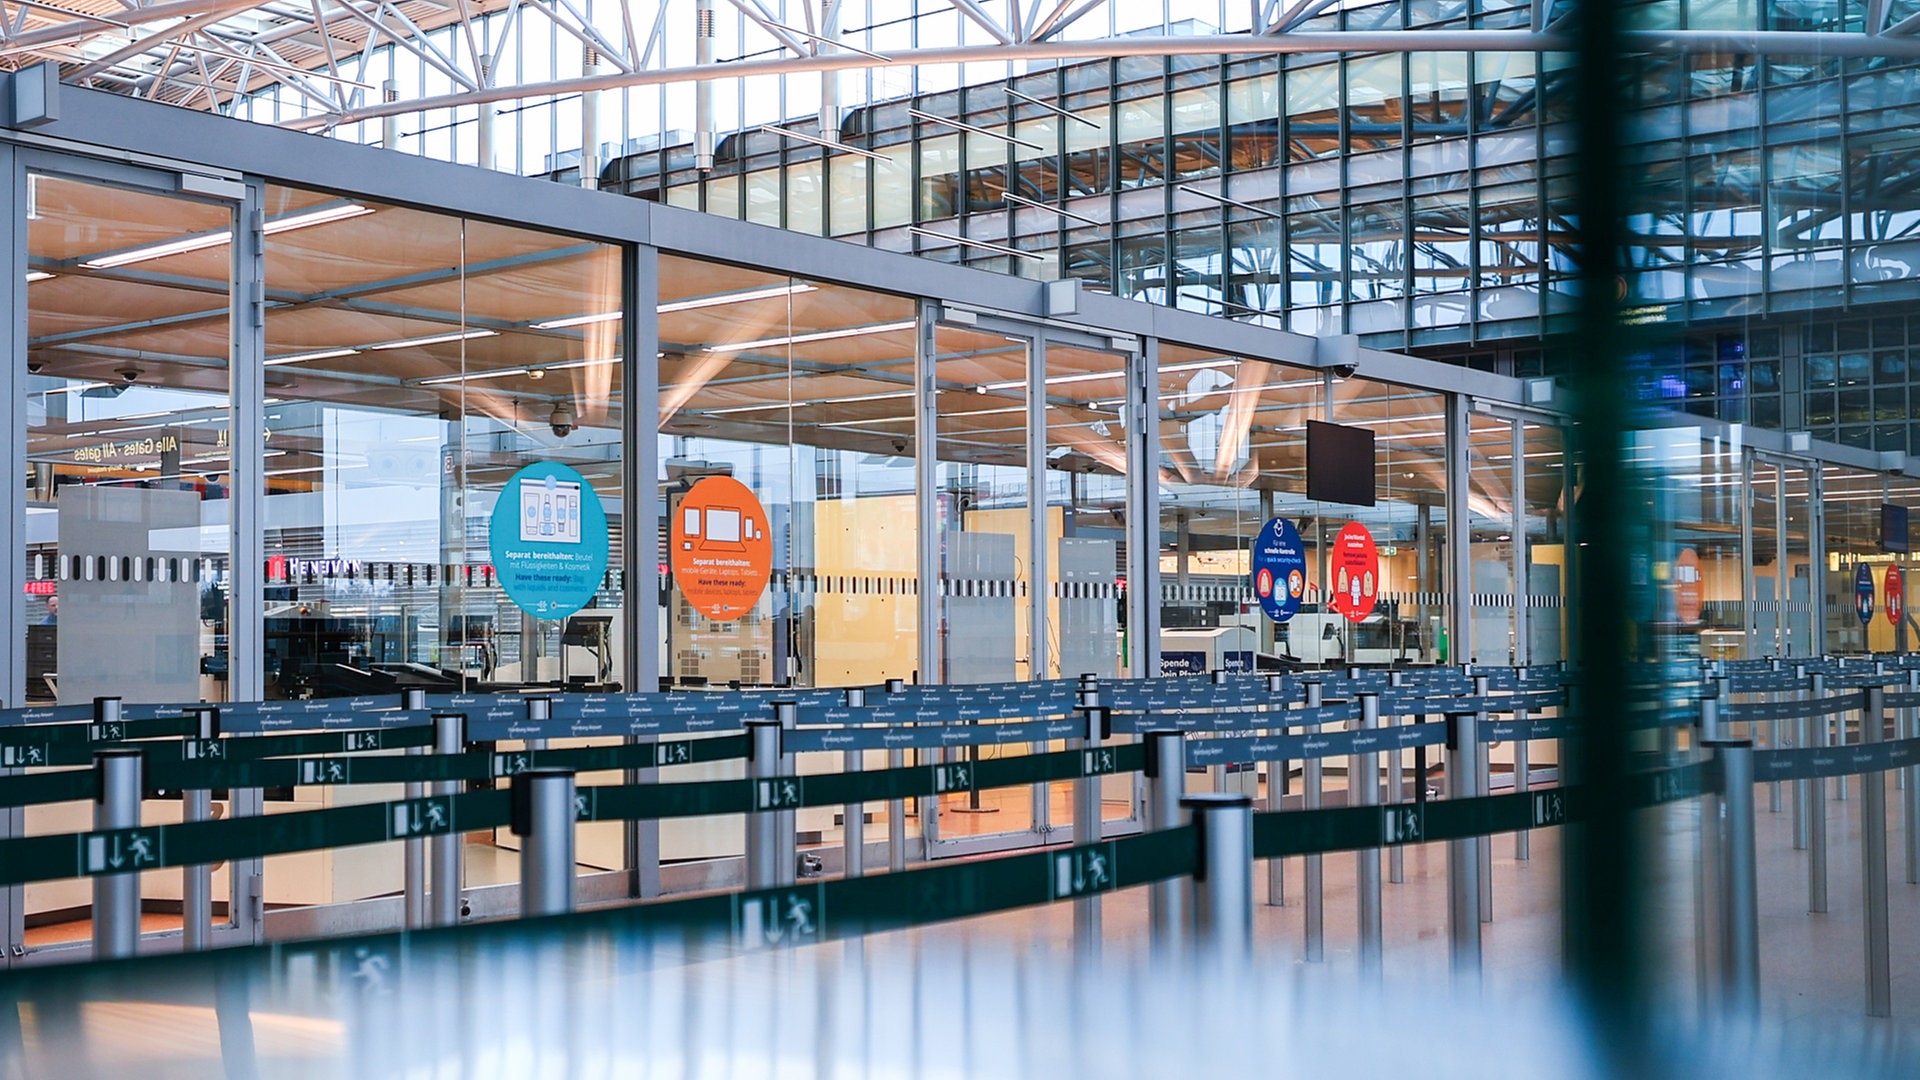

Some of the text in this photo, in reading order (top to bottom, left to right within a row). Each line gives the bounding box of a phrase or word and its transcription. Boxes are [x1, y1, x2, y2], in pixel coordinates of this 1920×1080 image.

[505, 550, 530, 560] Separat
[532, 552, 574, 561] bereithalten:
[565, 562, 590, 570] Kosmetik
[693, 558, 751, 567] Separat bereithalten:
[533, 574, 551, 582] these
[552, 574, 572, 583] ready:
[1160, 658, 1190, 668] Spende
[1225, 658, 1244, 669] Spene
